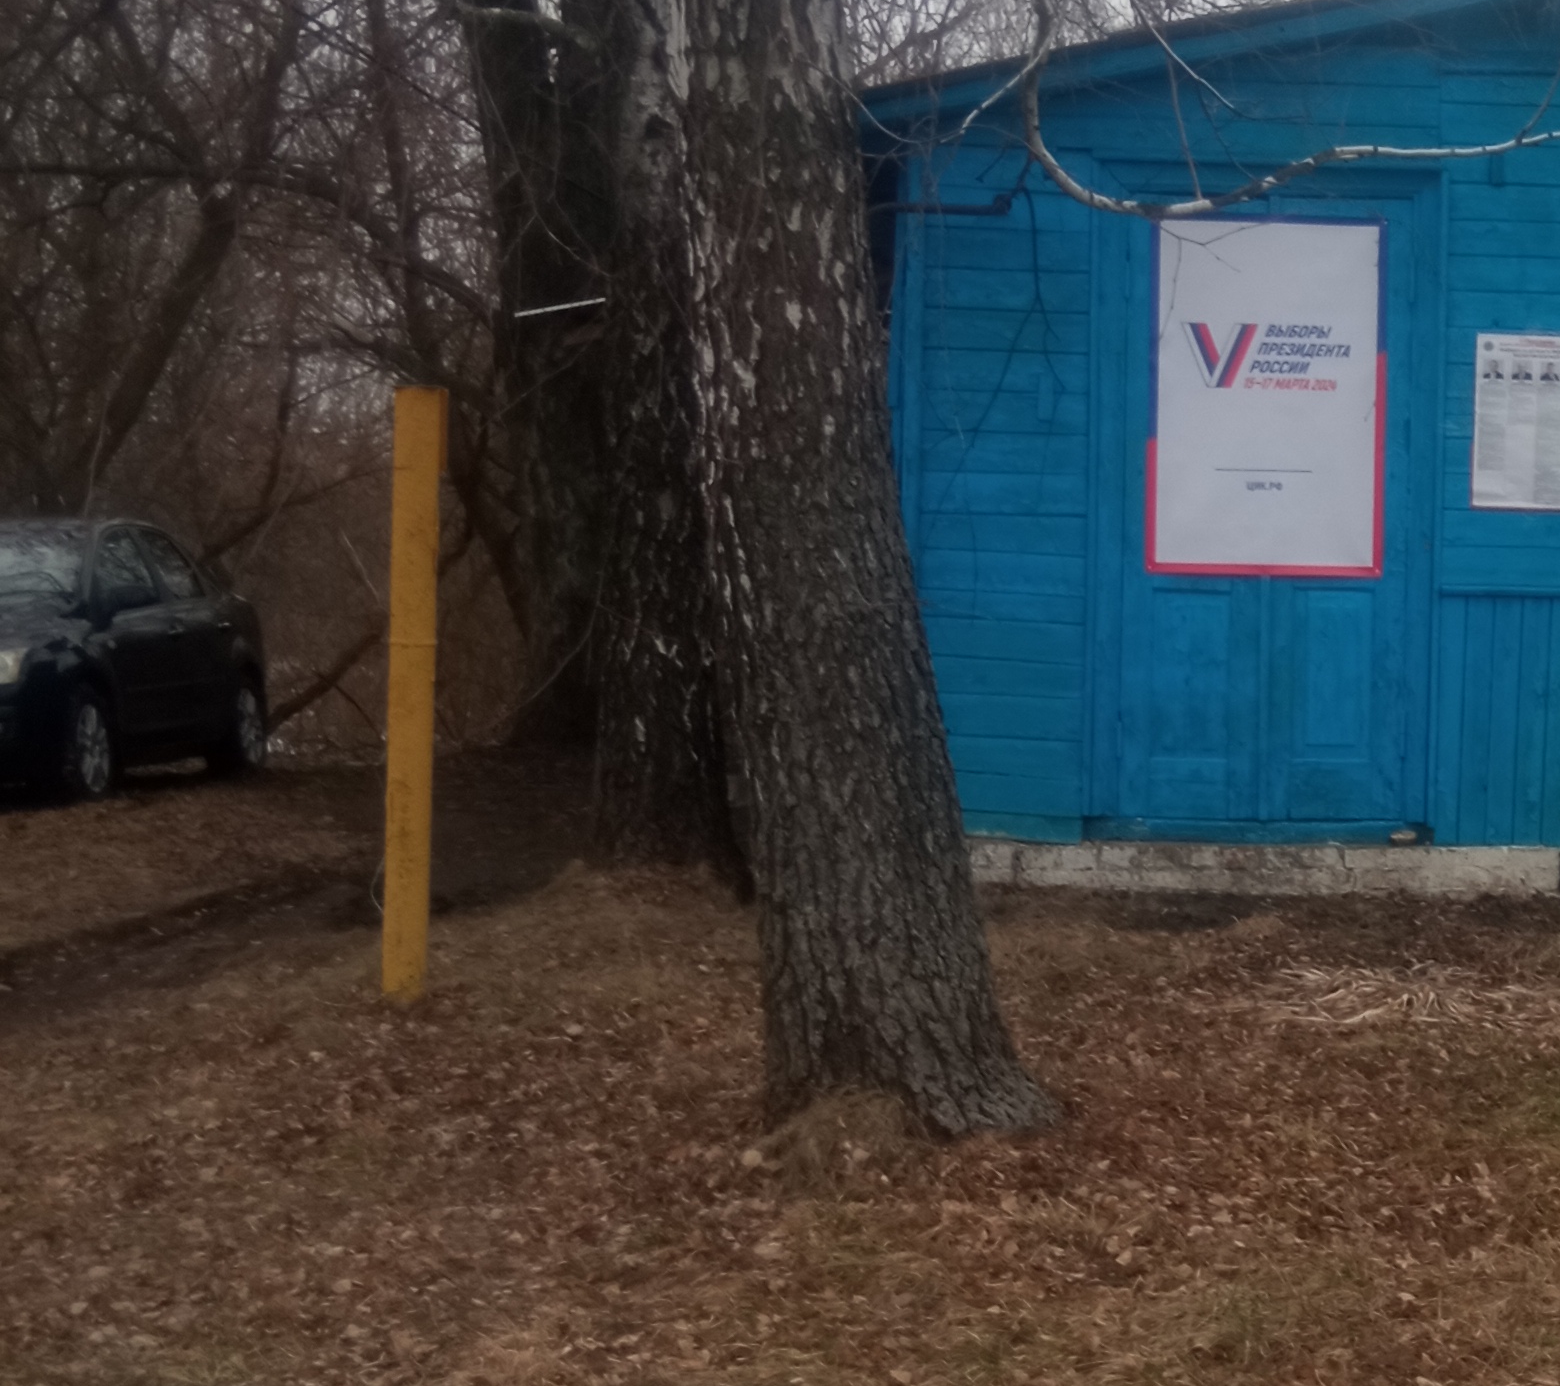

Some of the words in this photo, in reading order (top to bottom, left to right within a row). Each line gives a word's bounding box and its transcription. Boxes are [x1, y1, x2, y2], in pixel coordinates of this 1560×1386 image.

[1264, 324, 1332, 339] ВЫБОРЫ
[1257, 342, 1351, 358] ПРЕЗИДЕНТА
[1249, 360, 1311, 374] РОССИИ
[1275, 378, 1310, 390] МАРТА
[1311, 379, 1338, 391] 2024
